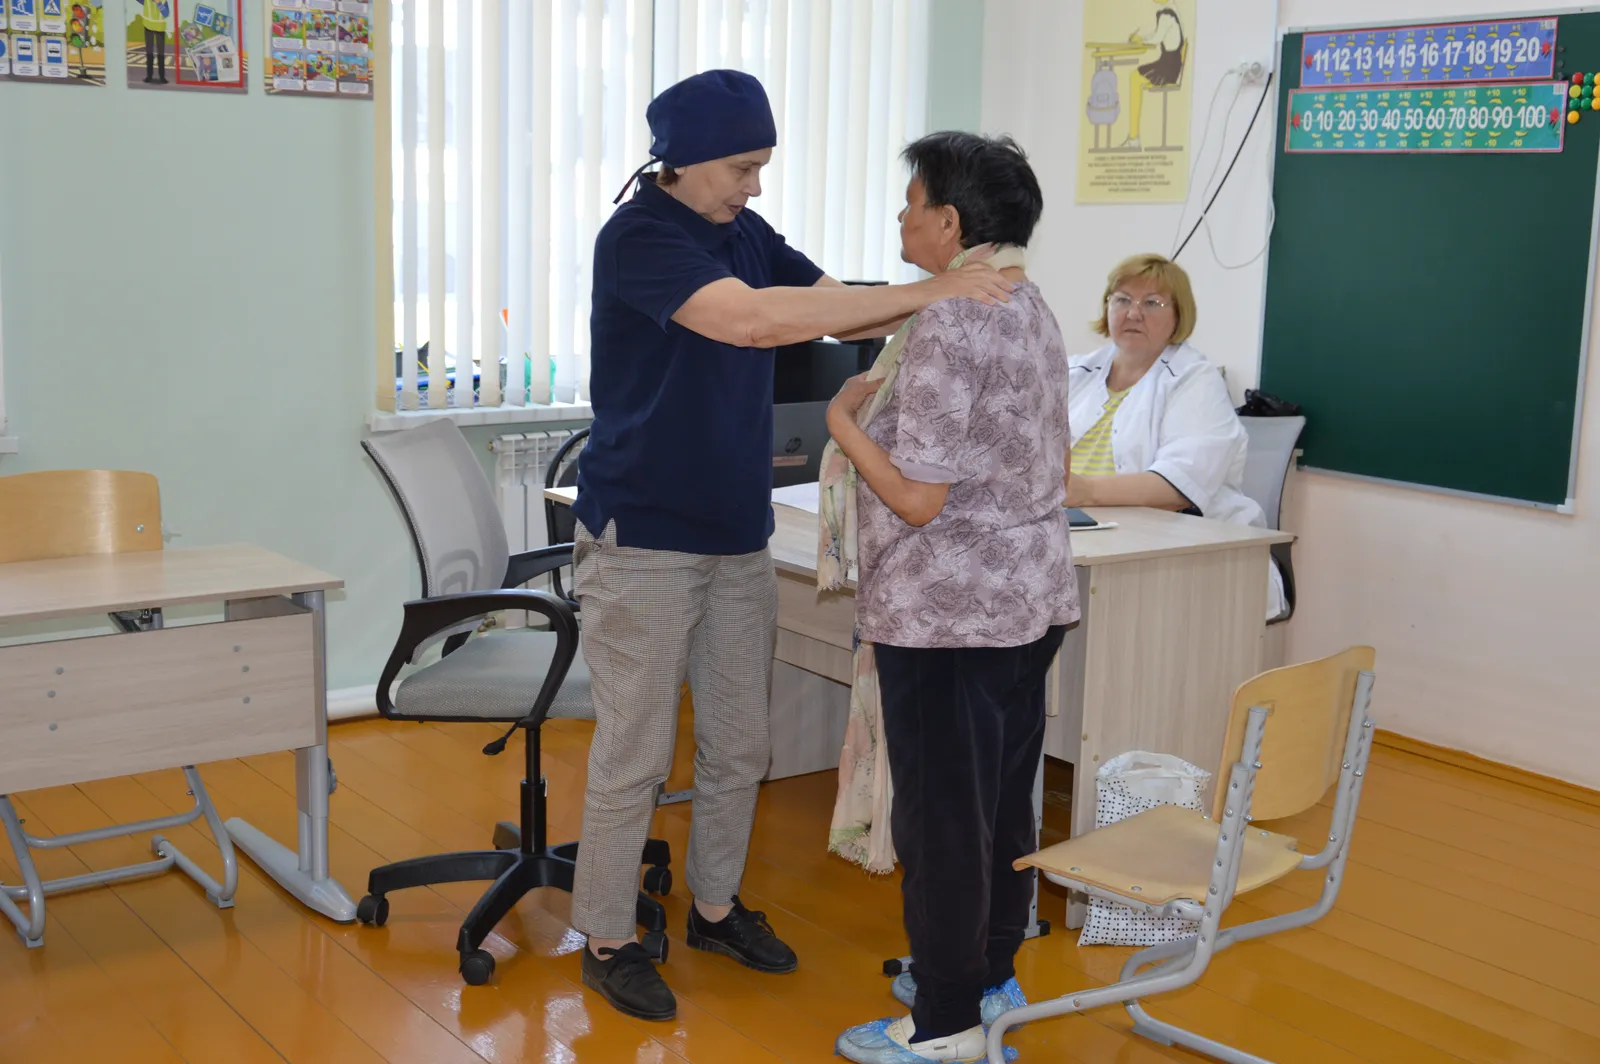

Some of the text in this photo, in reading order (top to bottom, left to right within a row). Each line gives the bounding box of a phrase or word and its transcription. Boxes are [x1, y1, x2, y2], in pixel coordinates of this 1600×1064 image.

[1314, 37, 1540, 72] 11 12 13 14 15 16 17 18 19 20
[1303, 105, 1546, 131] 0 10 20 30 40 50 60 70 80 90 100
